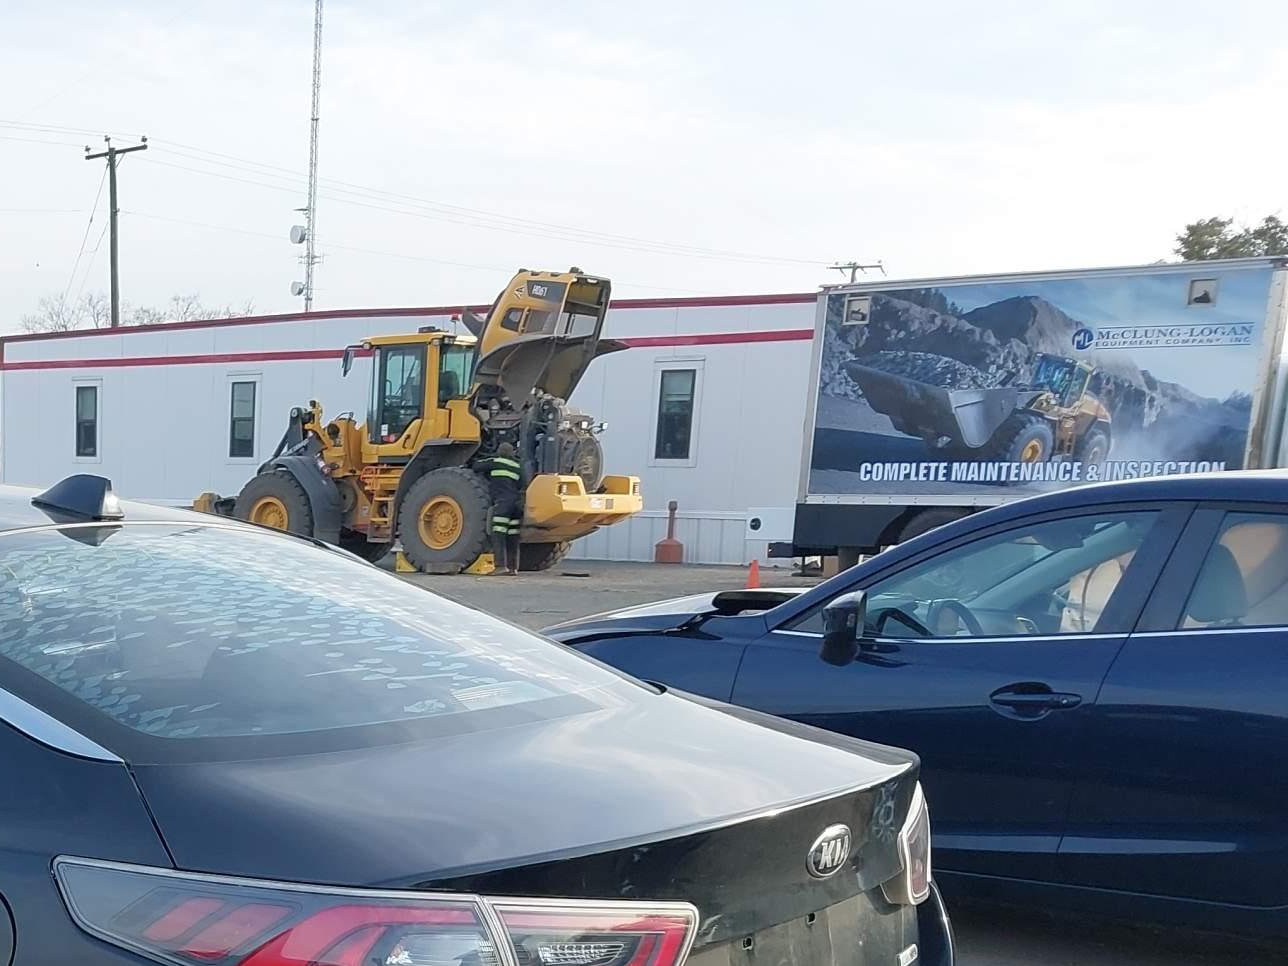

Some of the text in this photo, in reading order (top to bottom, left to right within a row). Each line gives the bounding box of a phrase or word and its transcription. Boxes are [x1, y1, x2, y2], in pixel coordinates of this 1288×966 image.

[860, 462, 948, 481] COMPLETE
[951, 462, 1082, 481] MAINTENANCE
[1086, 464, 1098, 481] &
